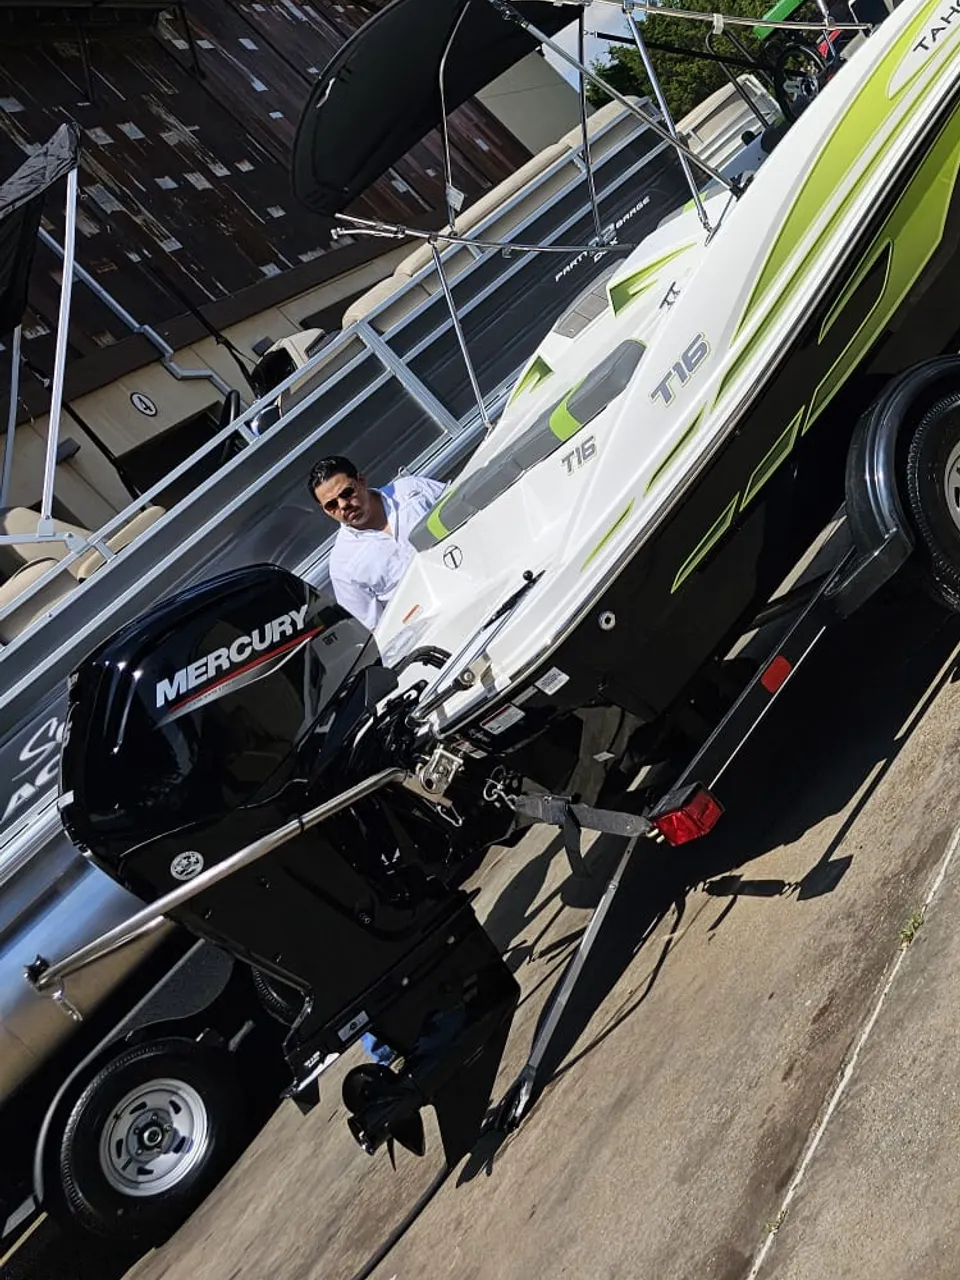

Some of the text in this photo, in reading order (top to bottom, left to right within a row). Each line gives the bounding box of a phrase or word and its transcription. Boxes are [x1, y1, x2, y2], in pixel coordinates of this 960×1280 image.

[615, 195, 650, 229] BARGE
[649, 332, 712, 407] T16
[560, 436, 597, 475] T16
[156, 604, 309, 708] MERCURY
